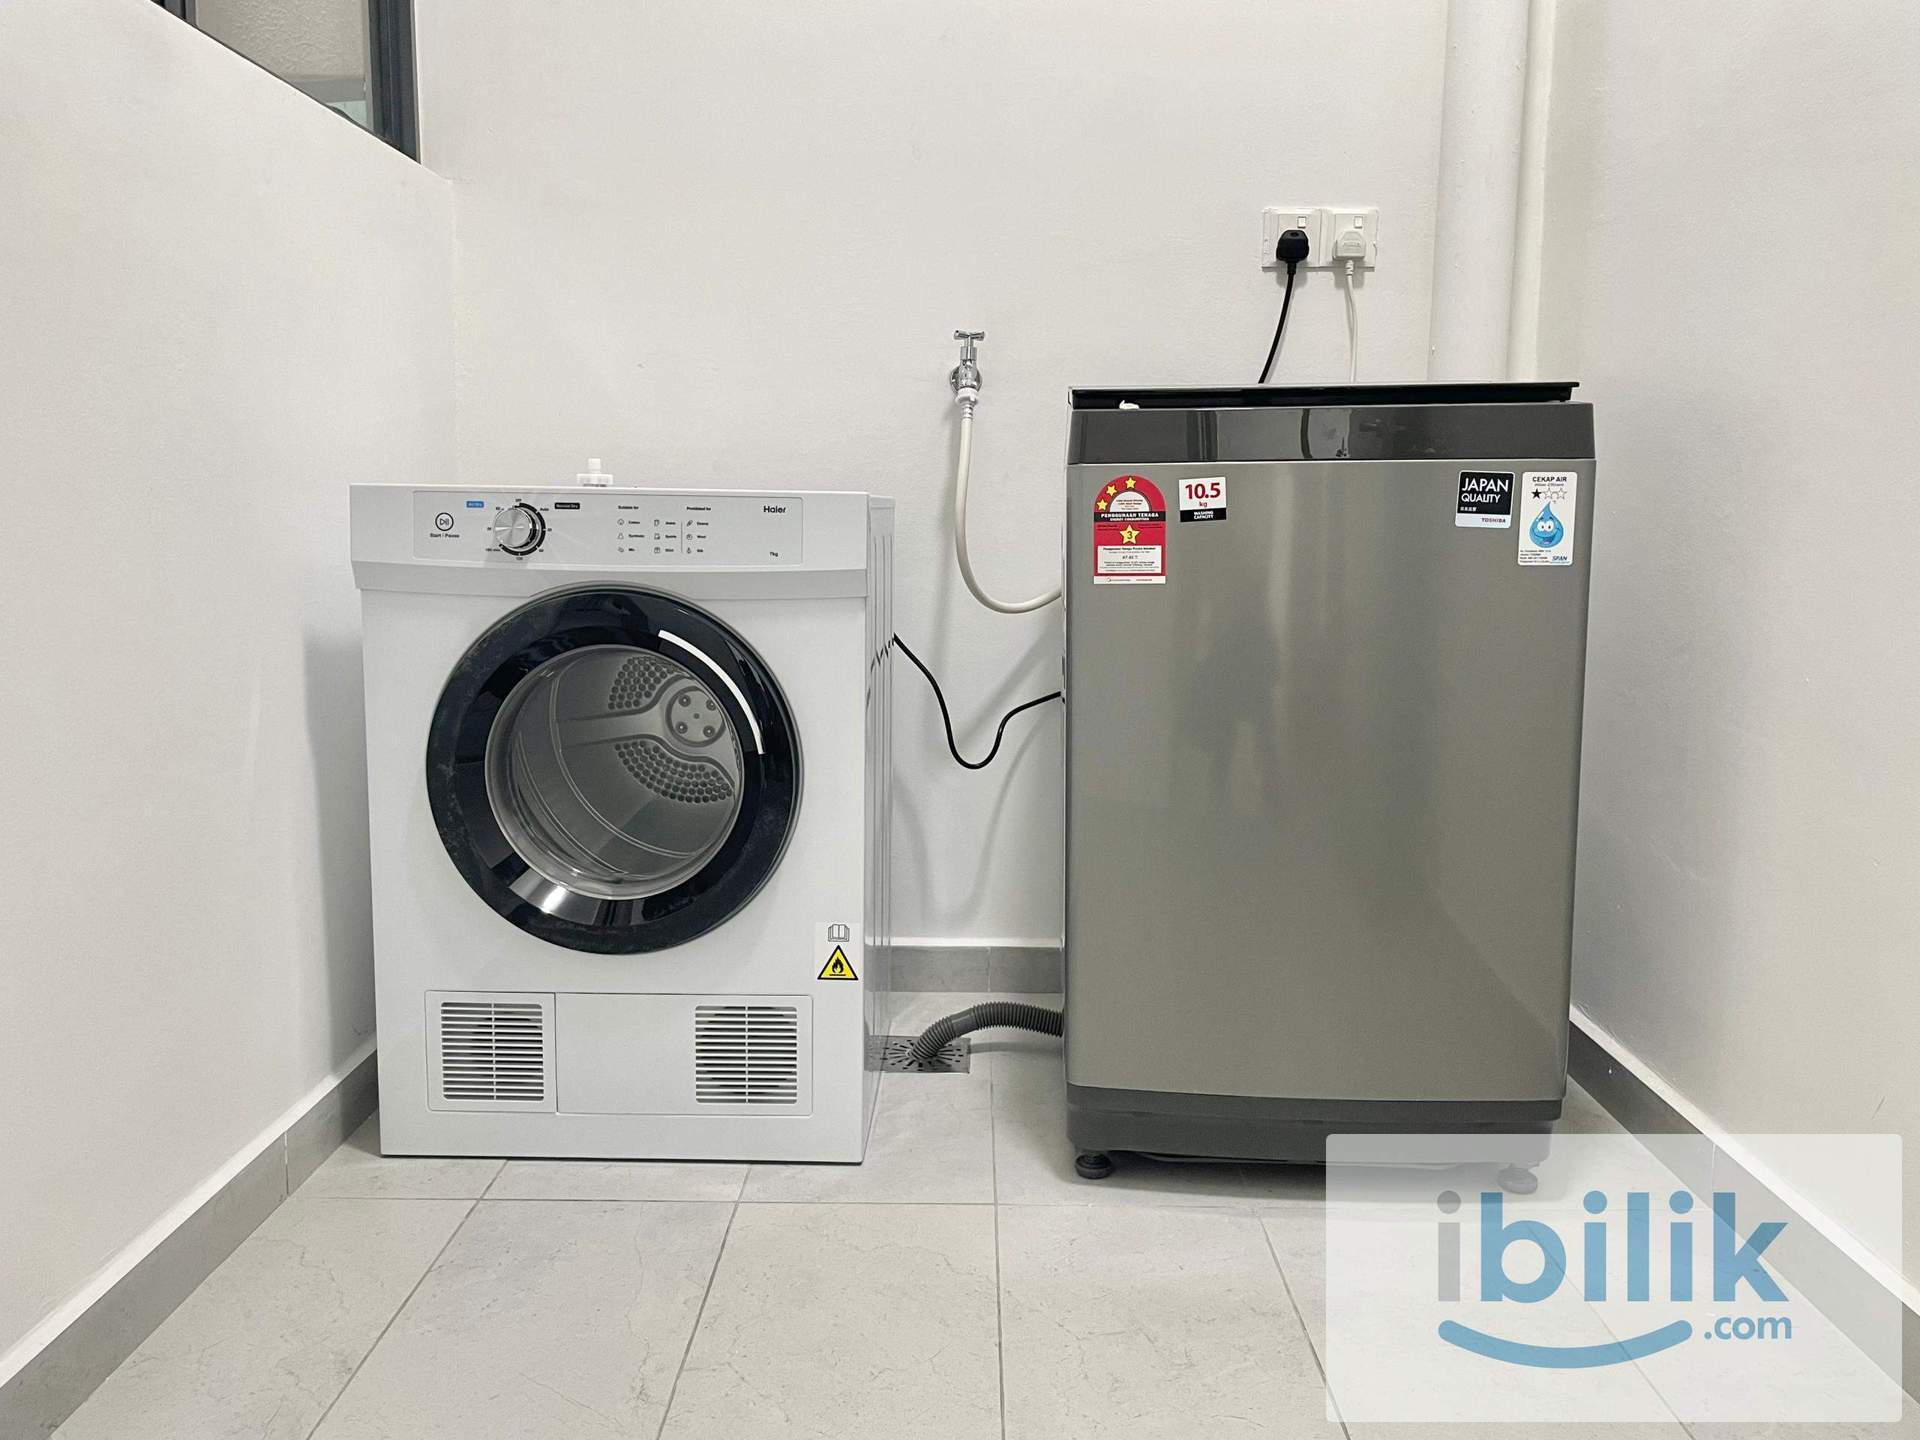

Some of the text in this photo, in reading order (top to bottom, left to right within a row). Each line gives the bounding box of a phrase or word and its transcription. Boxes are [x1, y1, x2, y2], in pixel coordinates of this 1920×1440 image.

[1461, 477, 1510, 492] JAPAN
[1185, 482, 1221, 500] 10.5
[1461, 493, 1501, 503] QUALITY
[763, 505, 787, 514] Haier
[1126, 530, 1133, 540] 3
